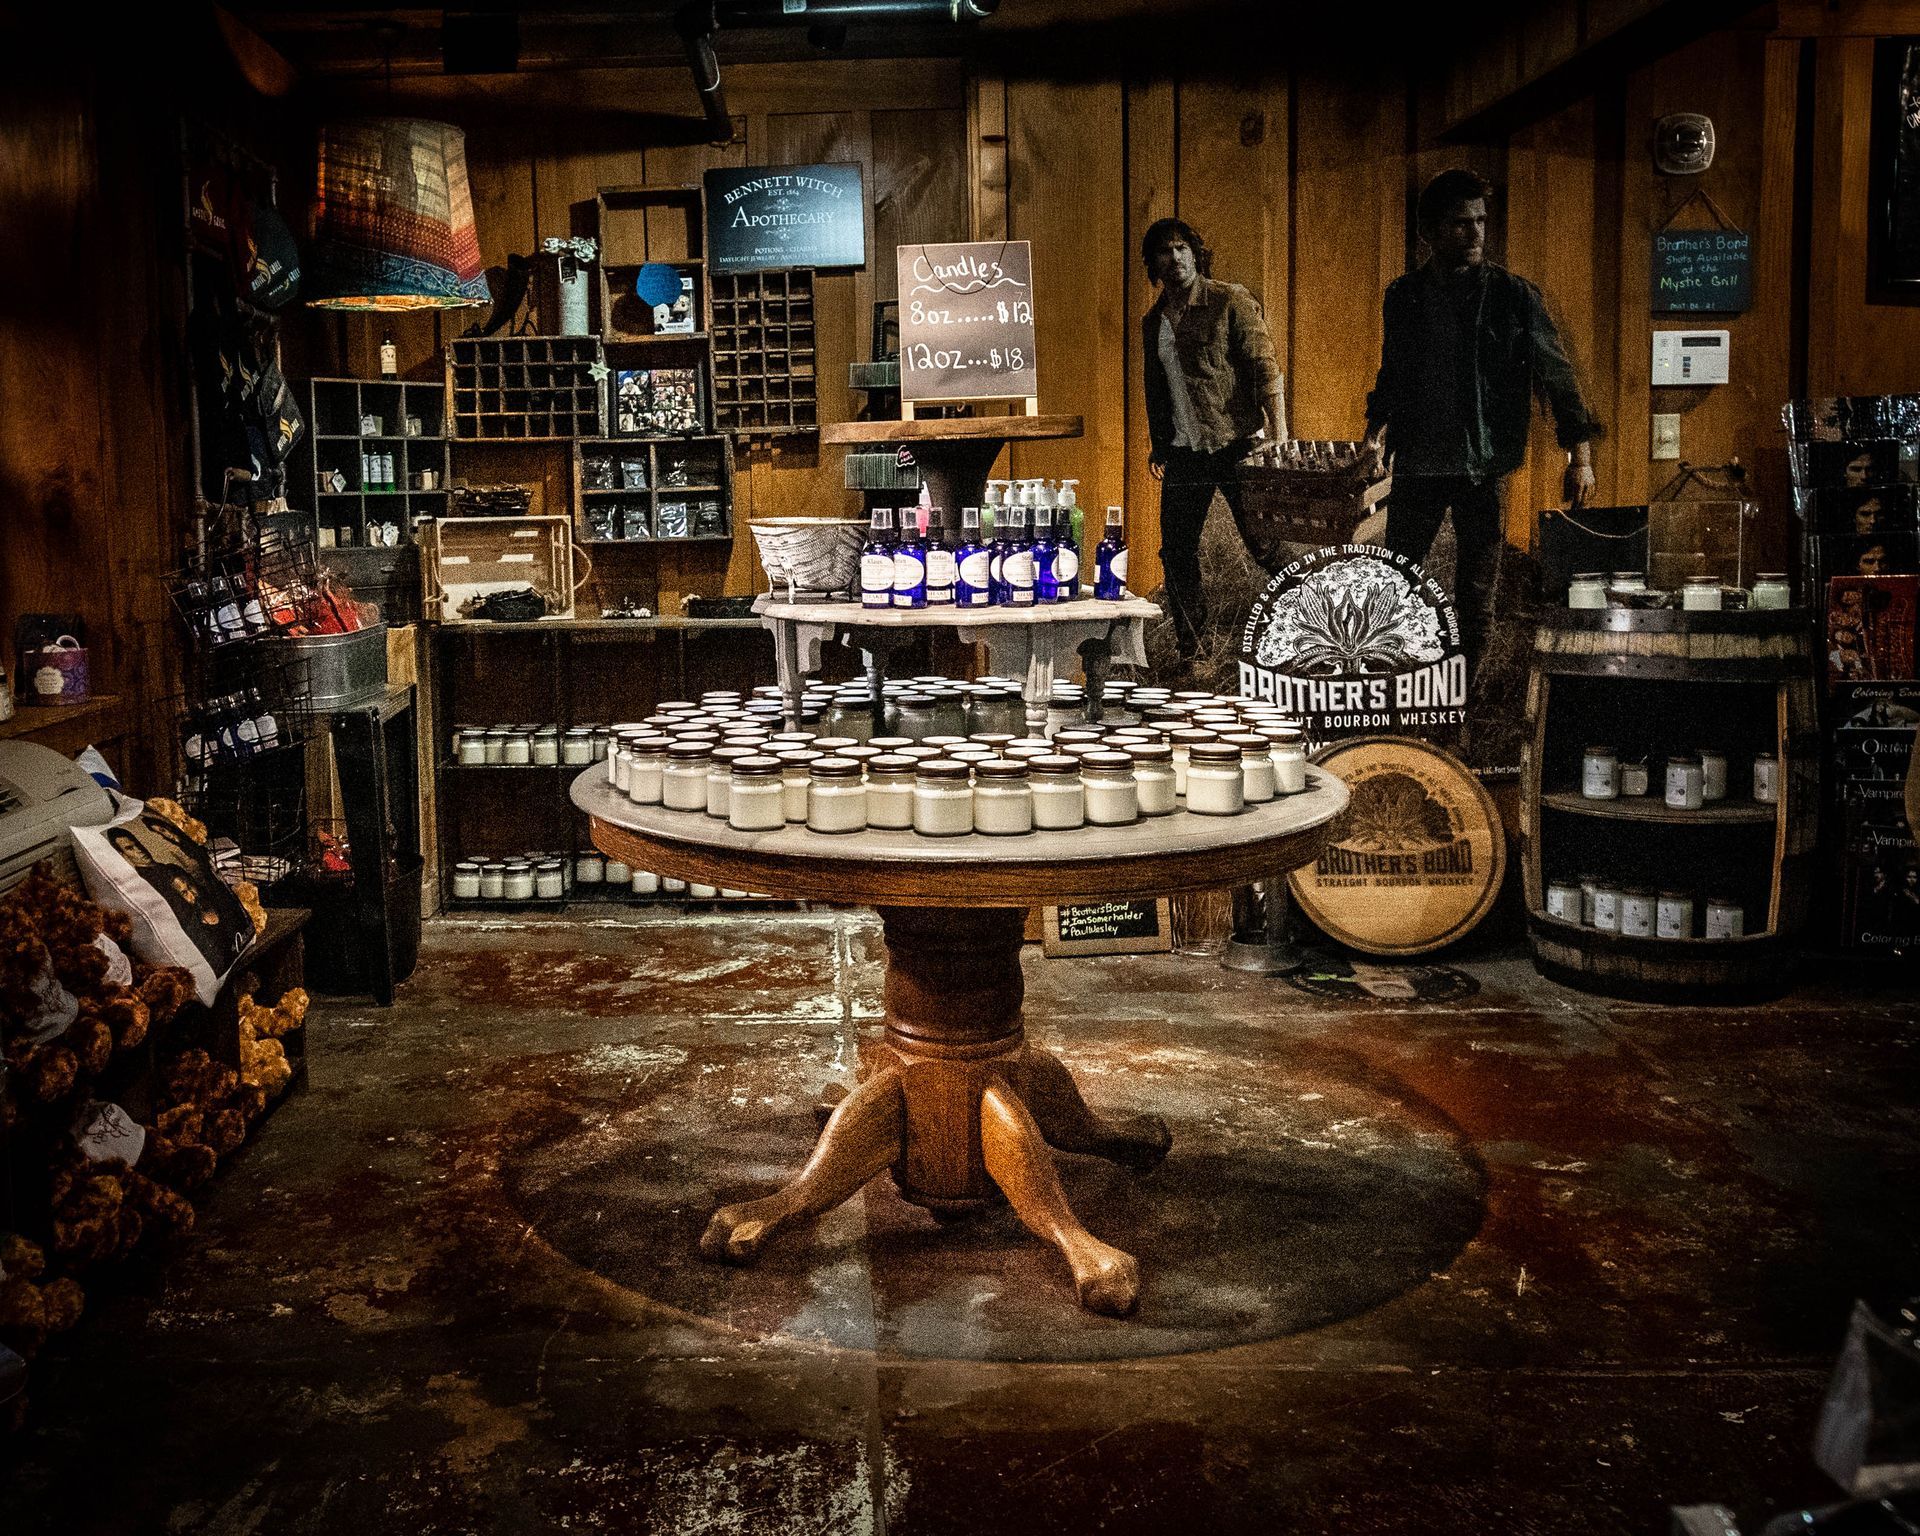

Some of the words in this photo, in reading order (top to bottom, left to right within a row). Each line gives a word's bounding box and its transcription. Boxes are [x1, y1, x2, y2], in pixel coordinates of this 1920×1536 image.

[724, 175, 793, 205] BENNETT
[796, 175, 844, 199] WITCH
[767, 188, 785, 197] EST.
[1657, 236, 1711, 252] Brother's
[1716, 235, 1749, 250] Bond
[1666, 255, 1692, 265] Shots
[1697, 252, 1748, 262] Available
[913, 256, 1003, 282] Candles
[1660, 276, 1703, 292] Mystic
[1711, 274, 1738, 287] Grill
[1242, 602, 1263, 653] DISTILLED
[1261, 592, 1269, 602] &
[1267, 561, 1301, 592] CRAFTED
[1302, 552, 1317, 566] IN
[1319, 545, 1338, 558] THE
[1342, 544, 1394, 560] TRADITION
[1395, 553, 1409, 566] OF
[1409, 563, 1426, 579] ALL
[1426, 577, 1449, 606] GREAT
[1442, 606, 1461, 647] BOURBON
[1238, 660, 1387, 713] BROTHER'S
[1396, 654, 1467, 709] BOND
[1852, 686, 1894, 700] Coloring
[1324, 714, 1391, 729] BOURBON
[1400, 710, 1467, 725] WHISKEY
[1424, 838, 1473, 874] BOND
[1316, 877, 1368, 888] STRAIGHT
[1375, 876, 1421, 887] BOURBON
[1428, 876, 1474, 887] WHISKEY
